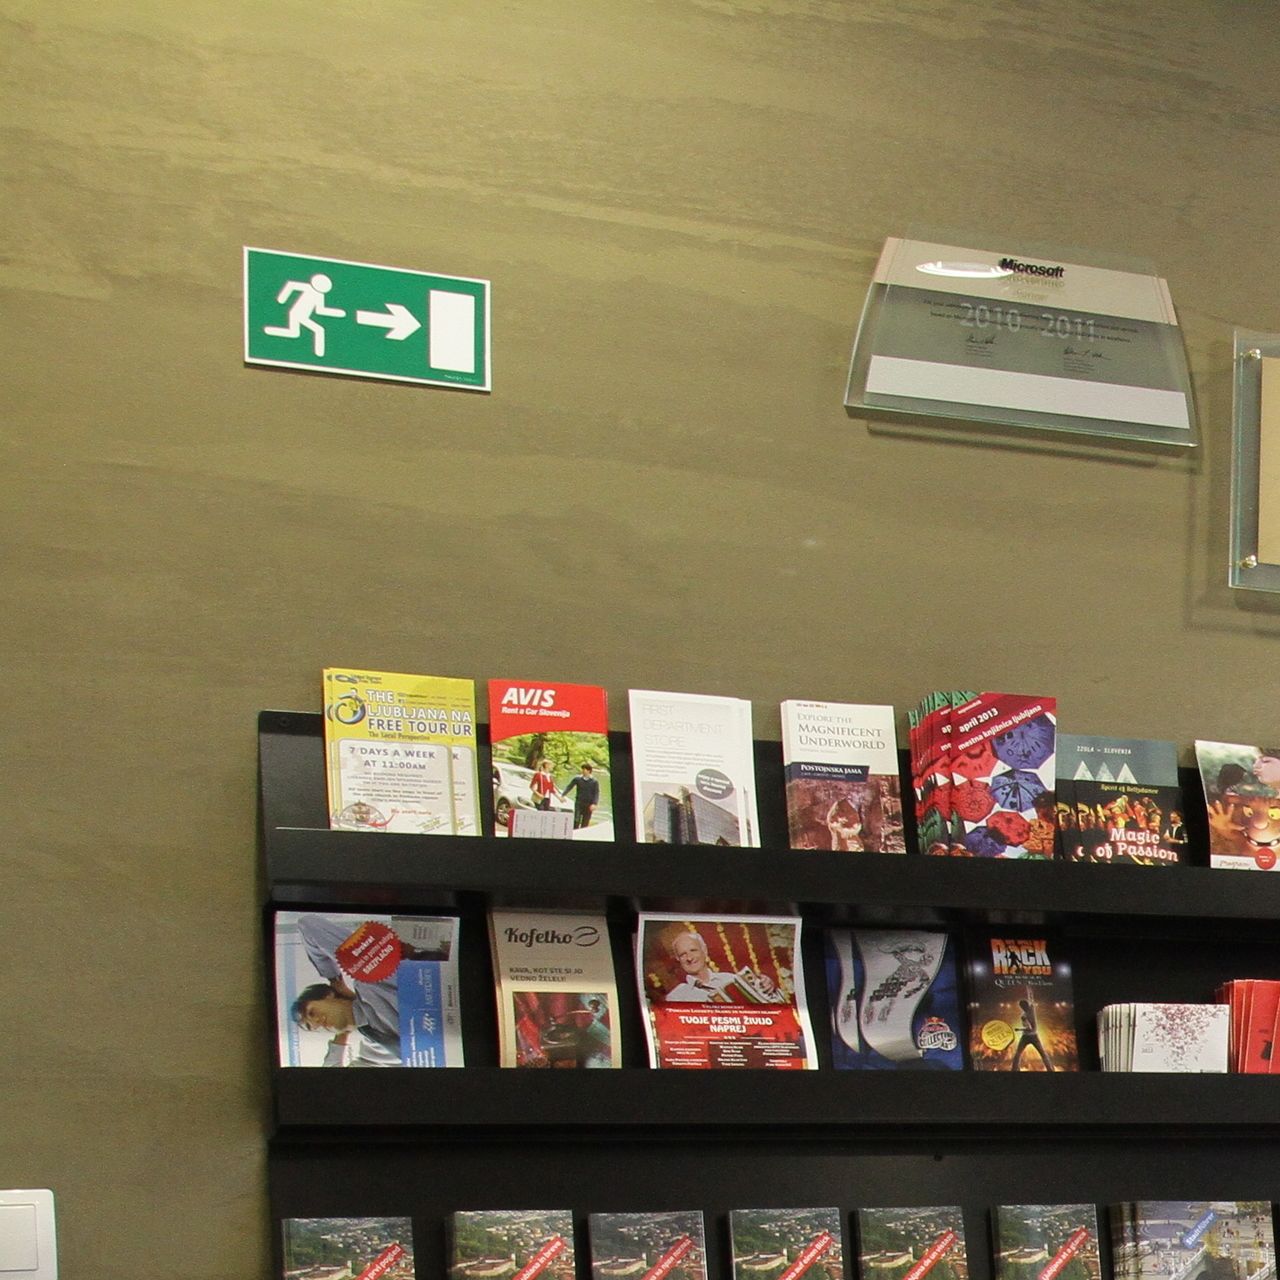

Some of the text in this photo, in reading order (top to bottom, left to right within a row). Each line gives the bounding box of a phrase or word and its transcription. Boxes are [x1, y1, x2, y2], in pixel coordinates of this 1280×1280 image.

[1001, 258, 1065, 278] Microsoft
[960, 303, 1021, 333] 2010
[1041, 312, 1095, 343] 2011
[366, 690, 394, 704] THE
[502, 687, 556, 706] AVIS
[367, 704, 448, 720] LJUBLJANA
[501, 707, 517, 716] Rent
[525, 707, 538, 716] Car
[539, 708, 571, 719] Slovenija
[959, 708, 998, 732] april 2013
[368, 719, 402, 731] FREE
[409, 721, 448, 735] TOUR
[798, 723, 882, 737] MAGNIFICENT
[958, 705, 1042, 750] mestna knjižnica ljubljana
[799, 735, 886, 750] UNDERWORLD
[349, 747, 357, 755] 7
[360, 747, 389, 756] DAYS
[405, 750, 436, 759] WEEK
[364, 760, 377, 768] AT
[801, 764, 843, 773] POSTOJNSKA
[1110, 828, 1160, 845] Magic
[1096, 843, 1179, 862] of Passion
[679, 1016, 710, 1025] TVOJE
[711, 1016, 741, 1024] PESMI
[709, 1024, 747, 1033] NAPREJ
[793, 1262, 804, 1273] auf
[802, 1248, 818, 1264] einen
[815, 1235, 830, 1250] Blick
[367, 1265, 382, 1280] prvi
[379, 1245, 401, 1268] pogled
[1041, 1257, 1065, 1280] Ljubljana
